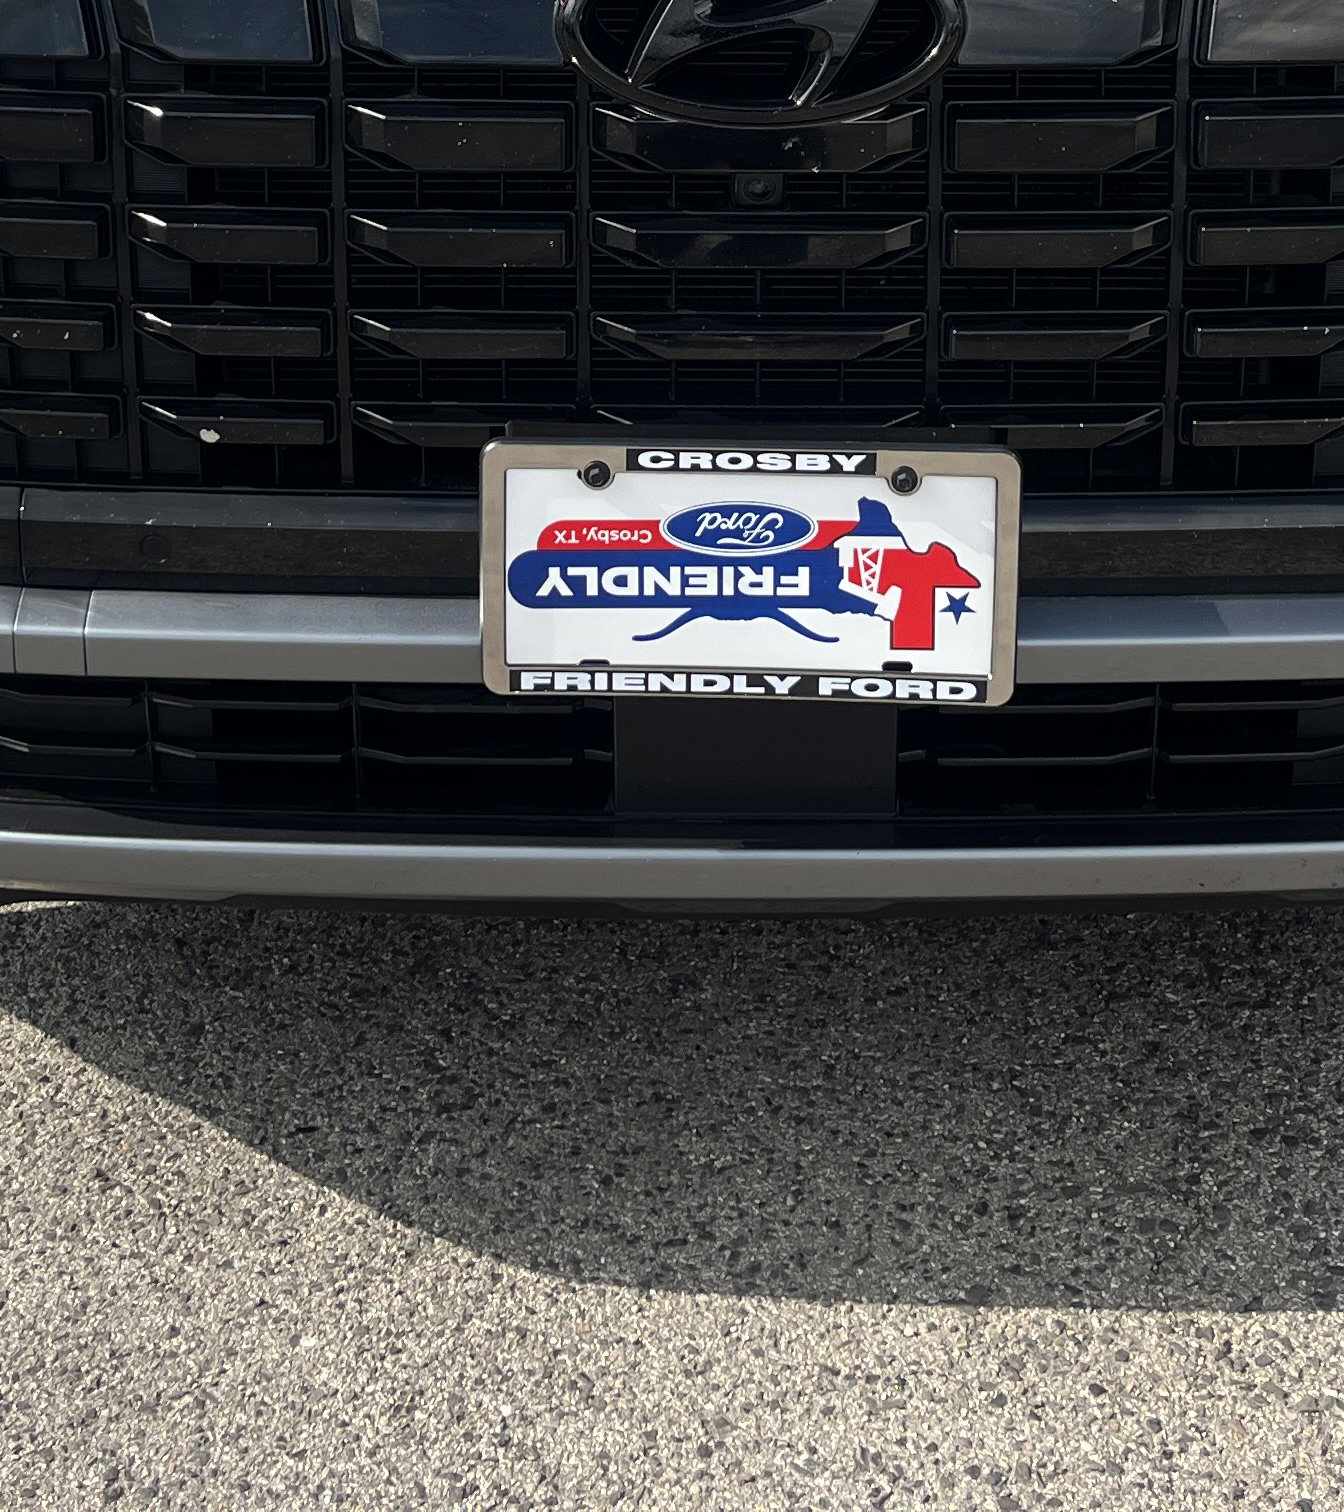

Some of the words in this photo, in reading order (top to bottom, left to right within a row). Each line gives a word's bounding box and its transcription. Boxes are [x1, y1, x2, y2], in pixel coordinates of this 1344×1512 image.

[637, 451, 868, 473] CROSBY
[553, 529, 580, 545] TX
[581, 526, 653, 544] Crosby,
[694, 511, 785, 547] Ford
[535, 565, 810, 597] FRIENDLY
[519, 670, 802, 695] FRIENDLY
[817, 676, 978, 701] FORD
